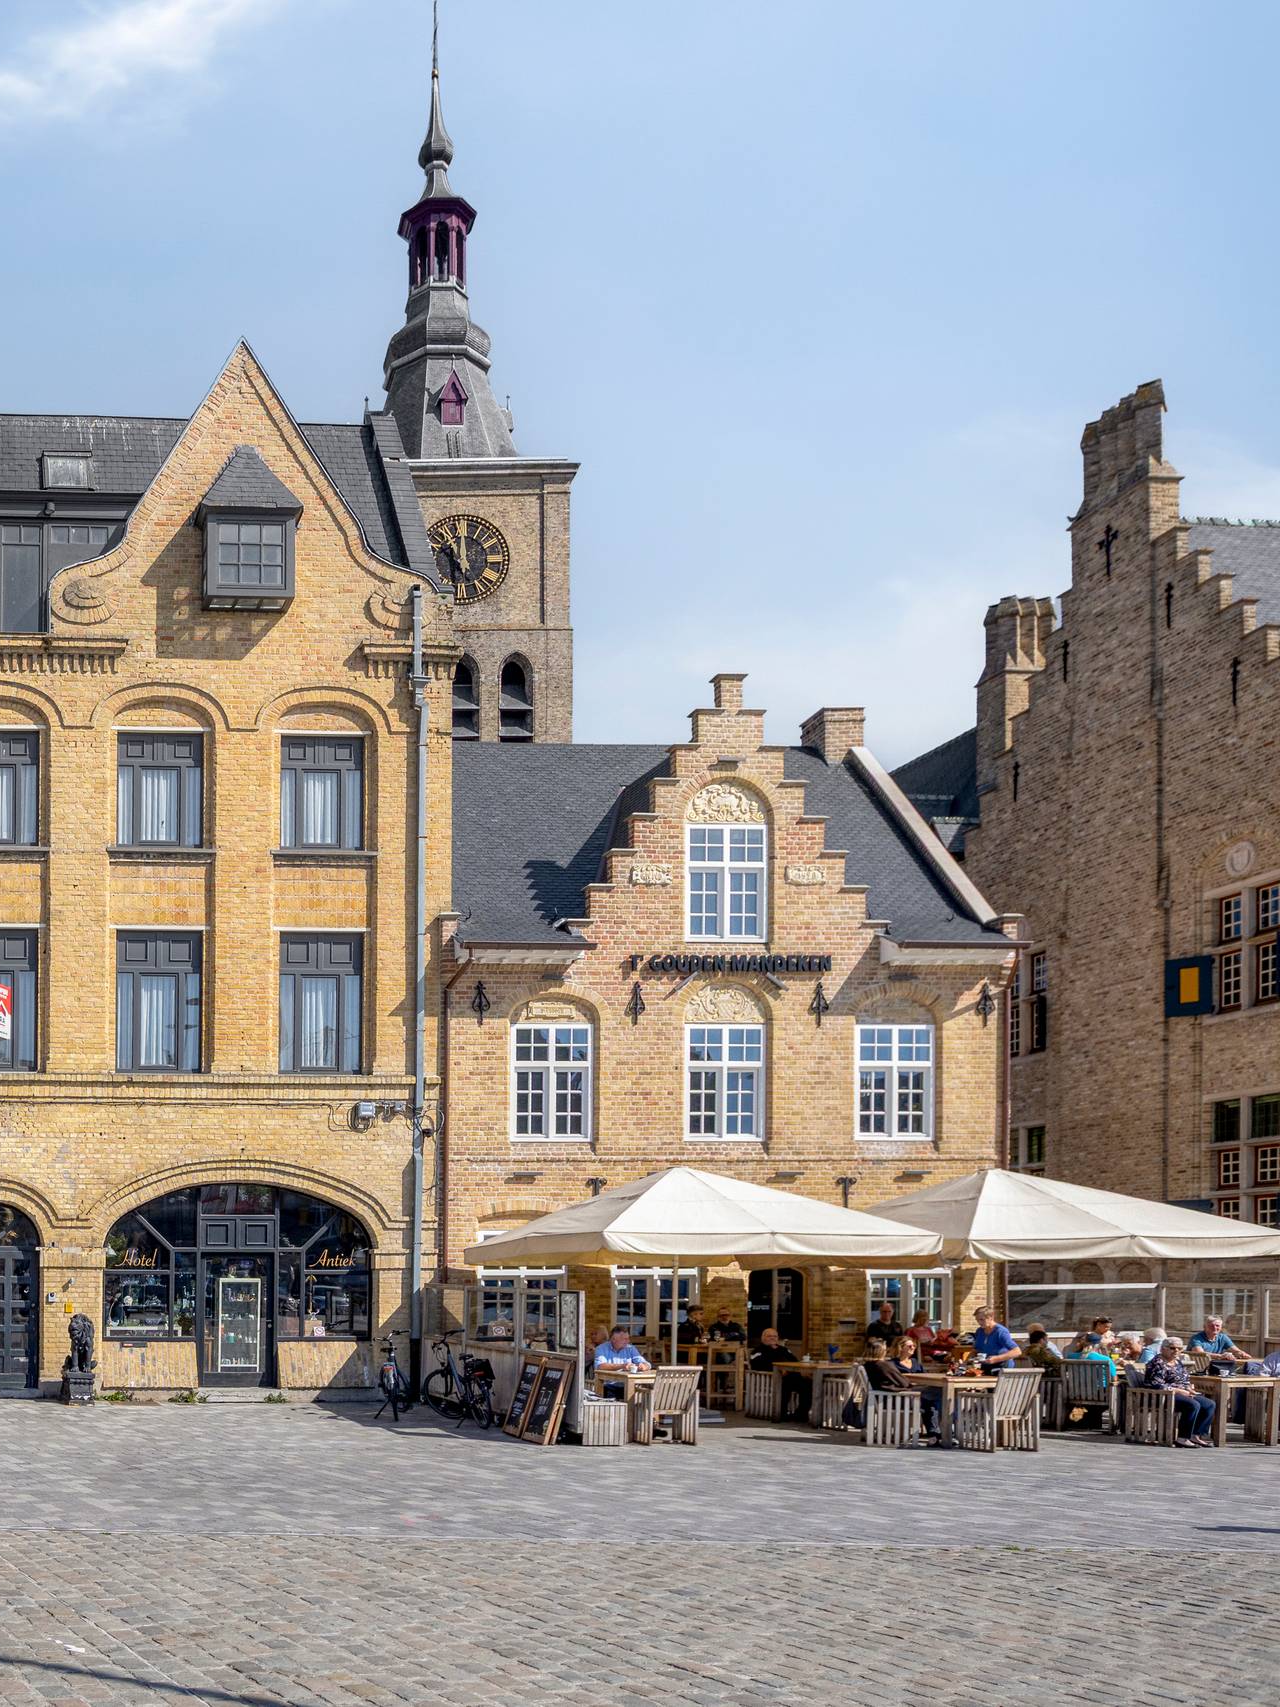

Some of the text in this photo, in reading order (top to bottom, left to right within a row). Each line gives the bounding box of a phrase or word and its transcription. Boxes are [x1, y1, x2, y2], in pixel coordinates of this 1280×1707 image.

[649, 954, 726, 973] GOUDEN
[730, 954, 833, 973] MANDEKEN
[114, 1247, 158, 1268] Hotel
[308, 1248, 357, 1268] Antiek
